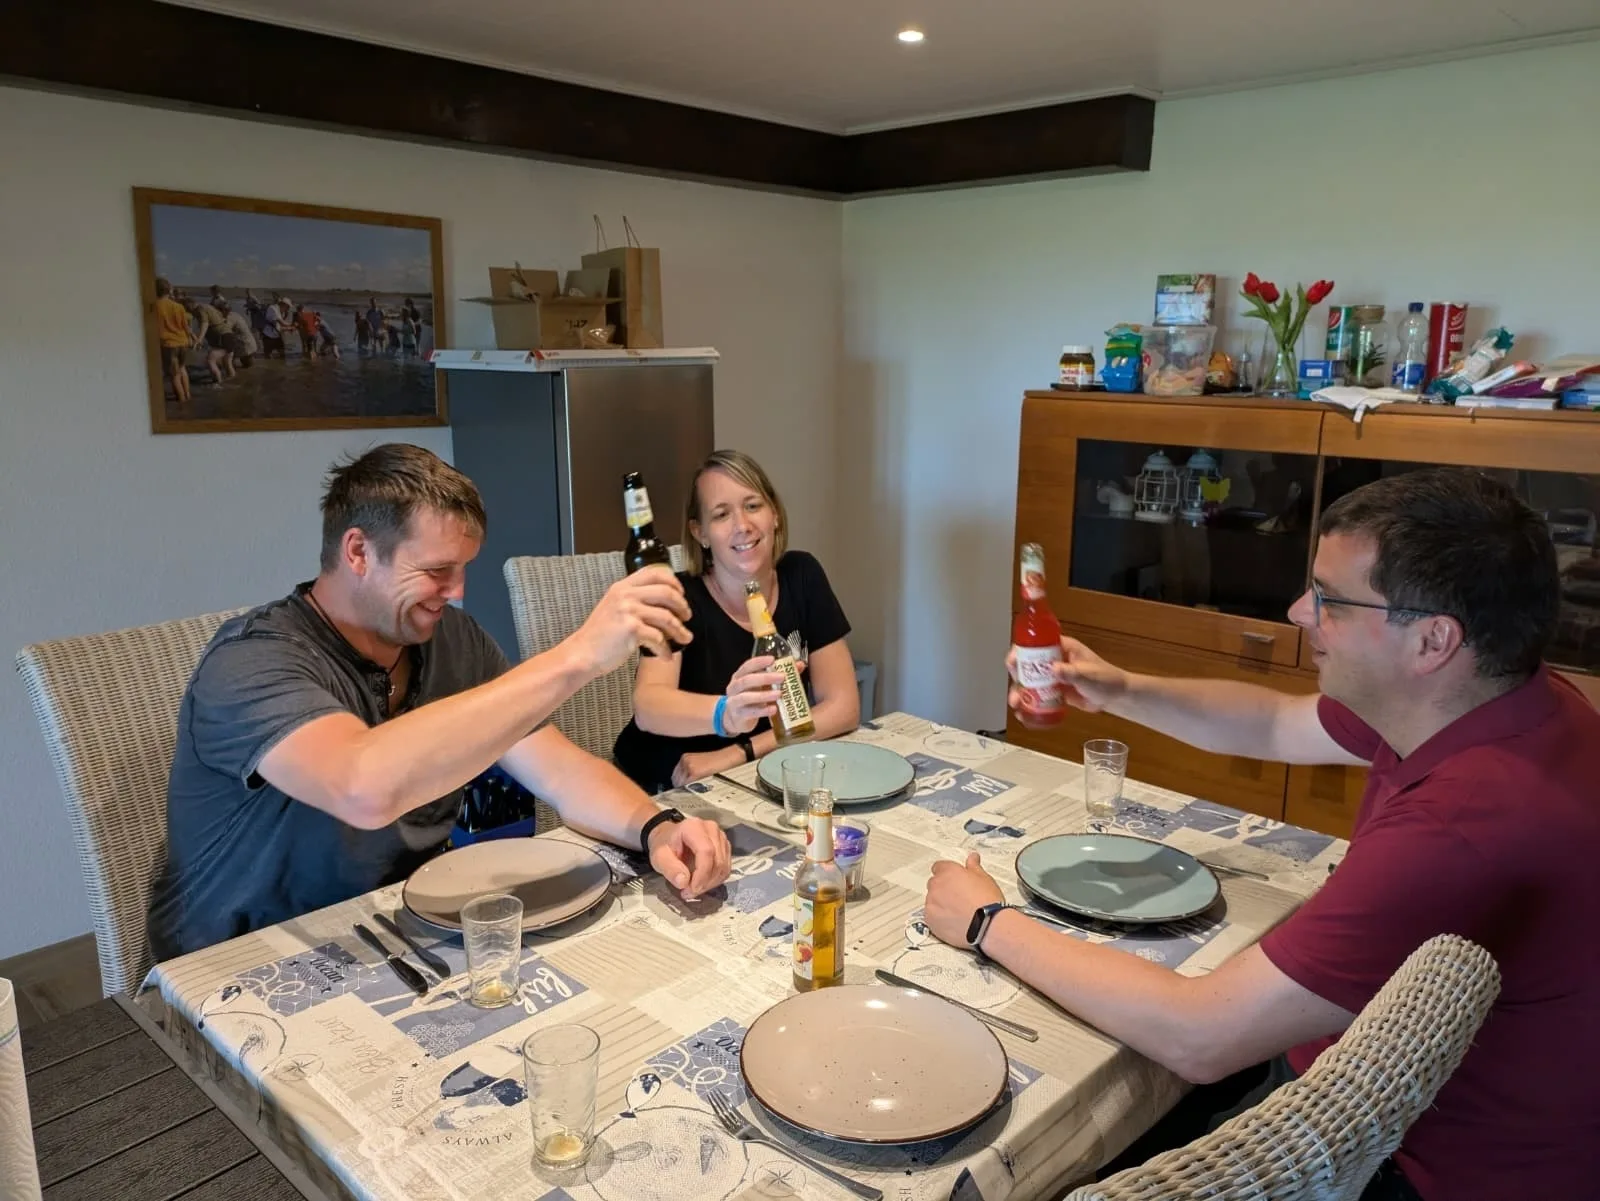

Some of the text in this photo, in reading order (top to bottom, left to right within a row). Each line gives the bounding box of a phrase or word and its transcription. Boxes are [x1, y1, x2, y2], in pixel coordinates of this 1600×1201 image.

[783, 661, 809, 719] FASSBRAUSE
[391, 1076, 409, 1109] FRESH
[441, 1132, 513, 1147] ALWAYS
